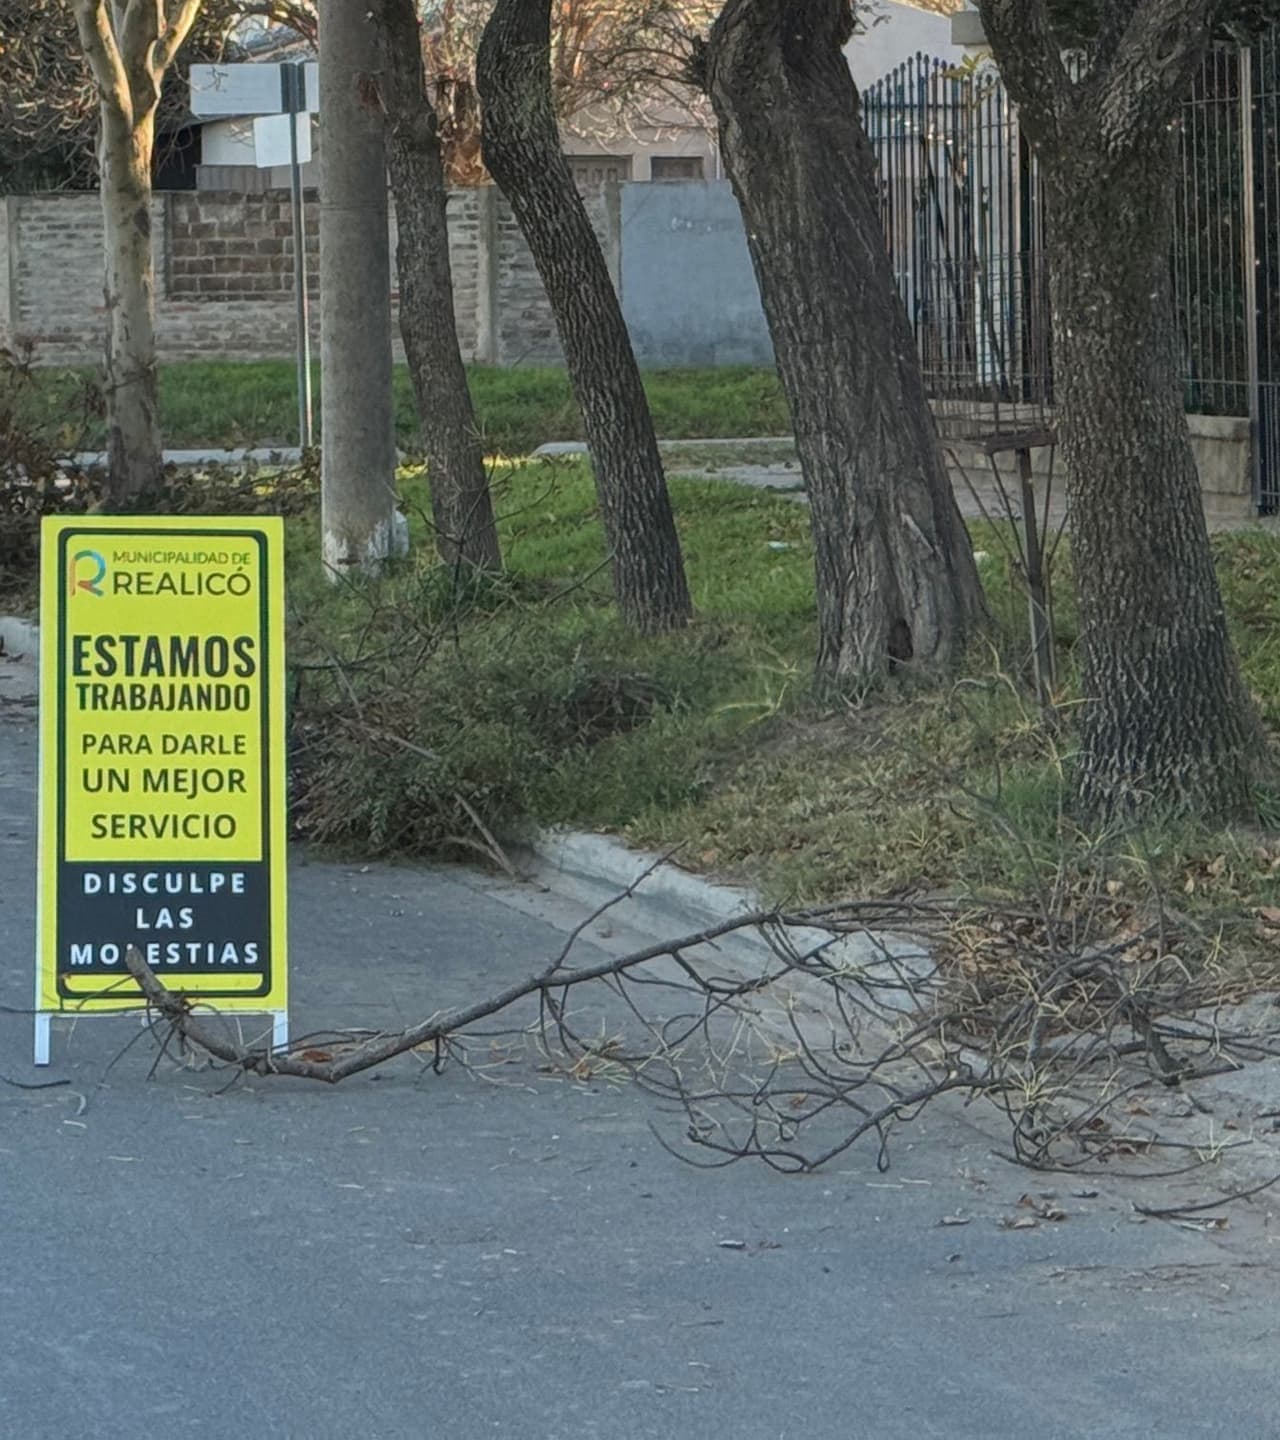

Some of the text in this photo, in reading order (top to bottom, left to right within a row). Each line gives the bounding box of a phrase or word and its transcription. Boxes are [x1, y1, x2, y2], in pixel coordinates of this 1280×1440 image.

[113, 551, 251, 565] MUNICIPALIDAD DE
[113, 566, 251, 596] REALICÓ
[73, 635, 255, 678] ESTAMOS
[76, 683, 250, 711] TRABAJANDO
[82, 734, 246, 755] PARA DARLE
[83, 769, 246, 799] UN MEJOR
[91, 814, 236, 839] SERVICIO
[84, 873, 245, 893] DISCULPE
[136, 908, 193, 929] LAS
[71, 943, 258, 965] MOESTIAS
